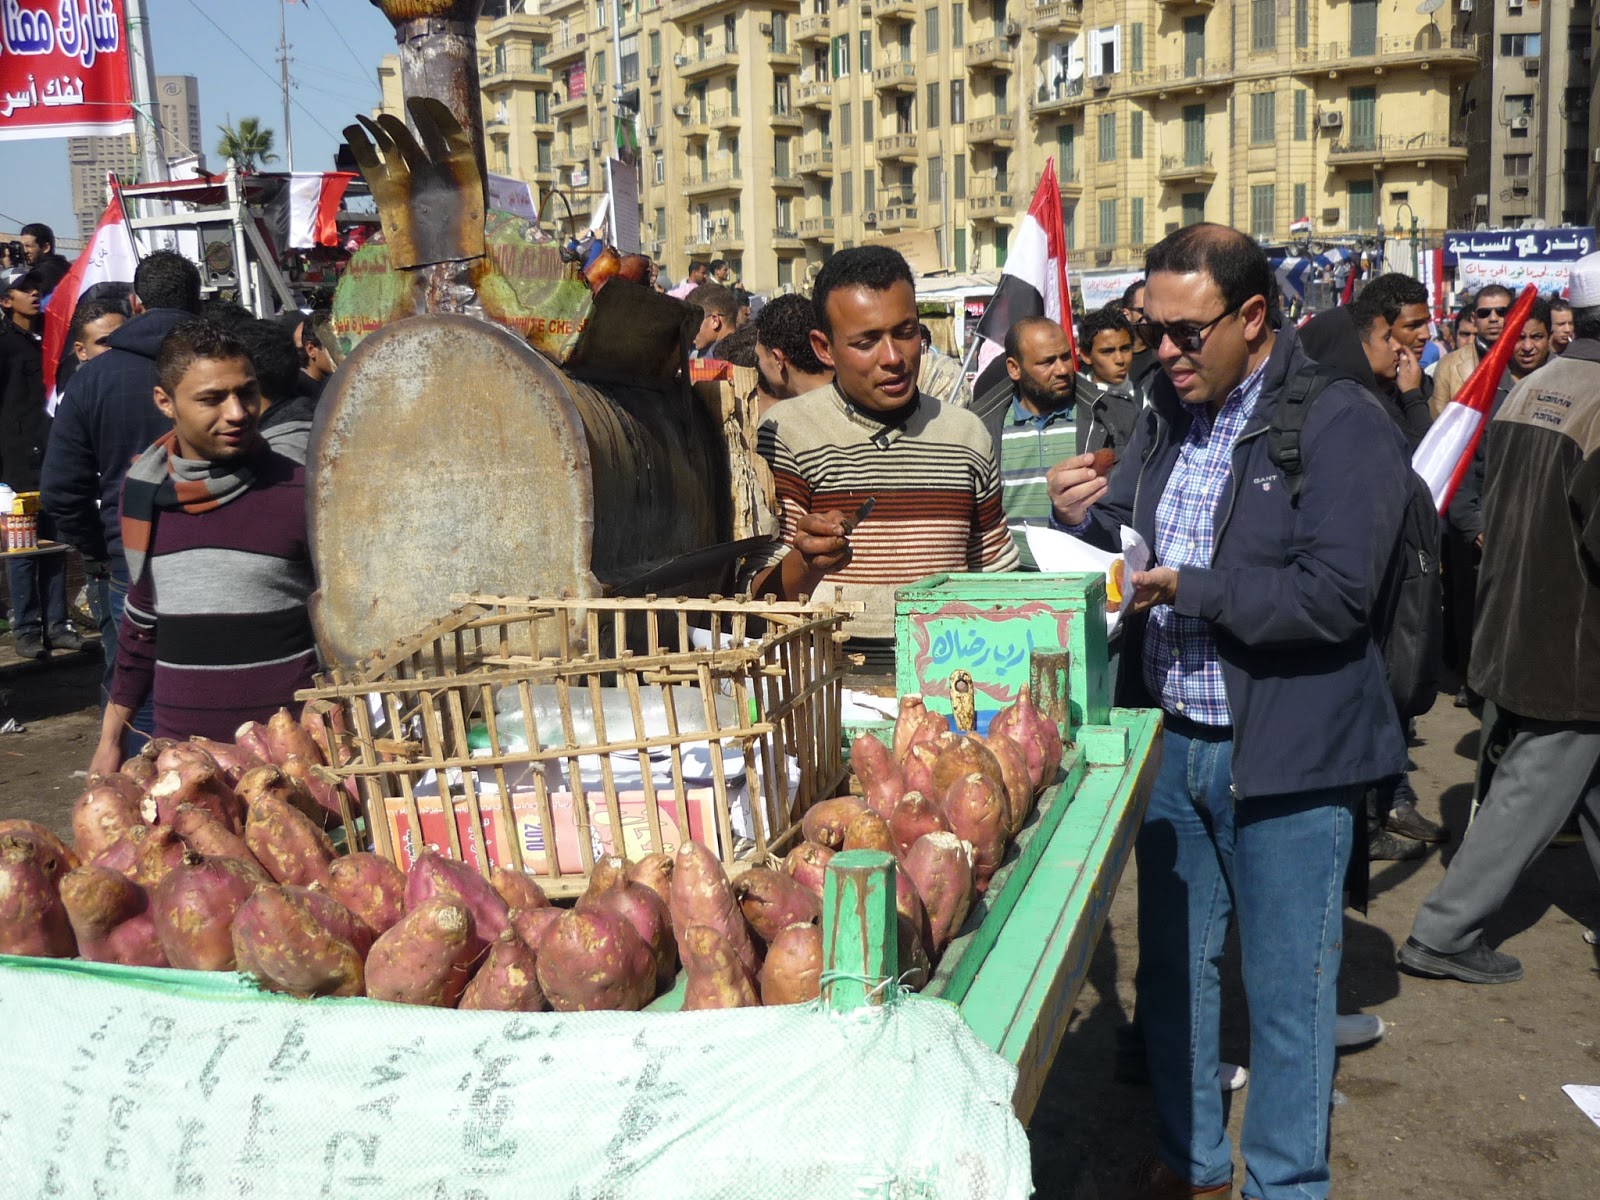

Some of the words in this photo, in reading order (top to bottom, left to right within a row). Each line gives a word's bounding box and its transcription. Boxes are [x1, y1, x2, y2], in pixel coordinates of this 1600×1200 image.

[42, 75, 84, 106] لفك
[1448, 236, 1511, 257] للسياحة
[1542, 233, 1589, 255] وندر
[1253, 475, 1278, 484] GANT
[524, 823, 546, 852] 2010
